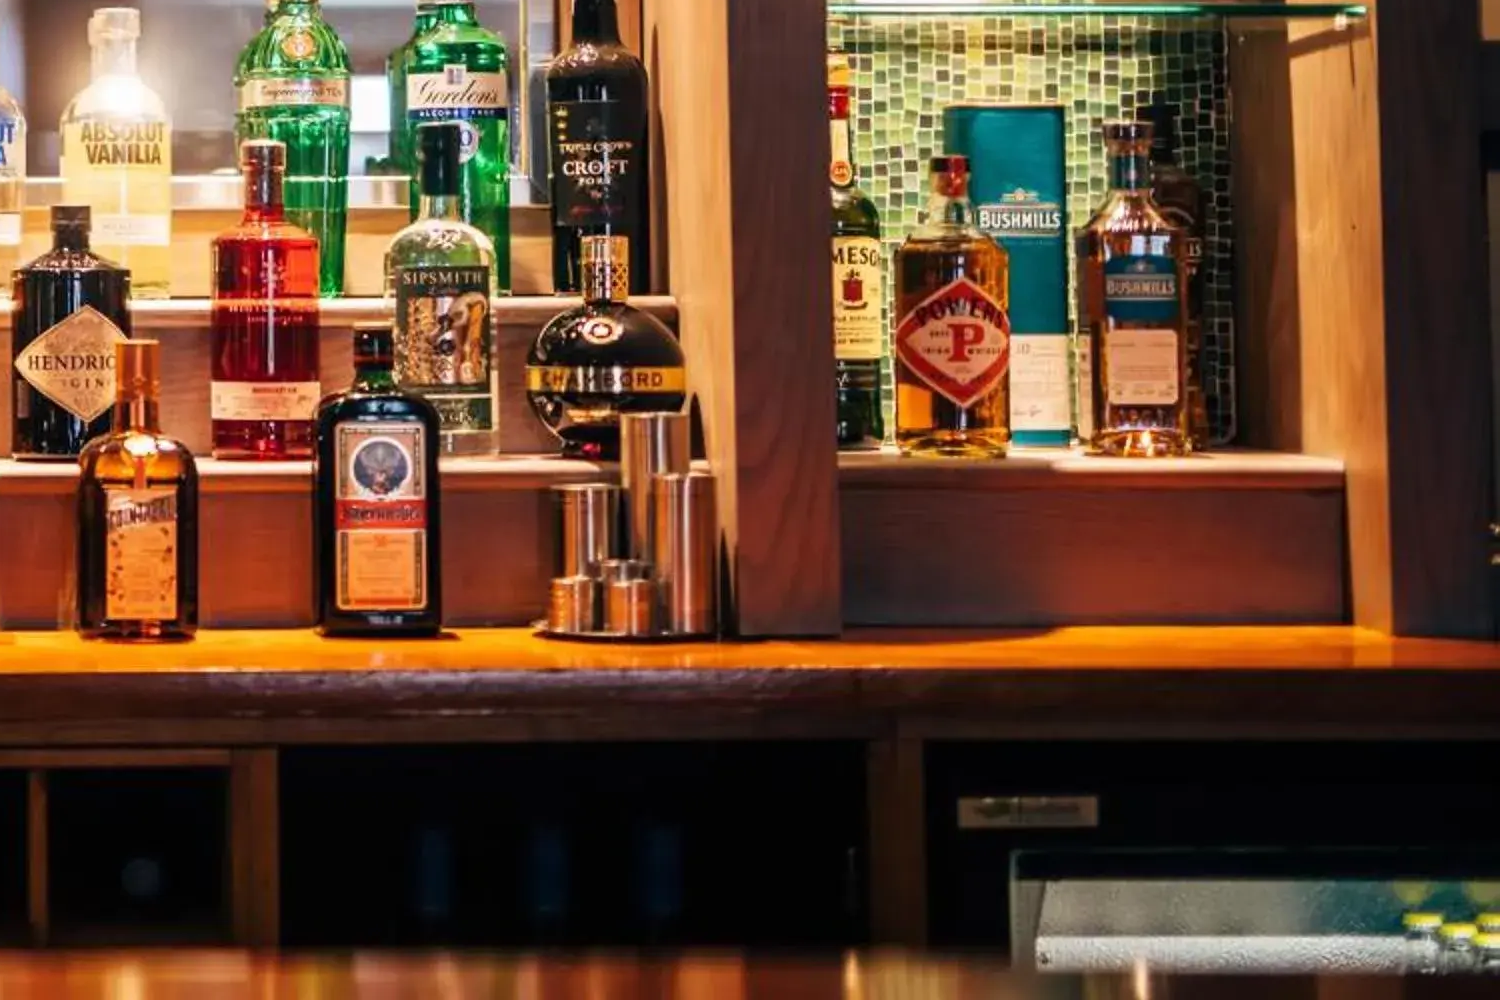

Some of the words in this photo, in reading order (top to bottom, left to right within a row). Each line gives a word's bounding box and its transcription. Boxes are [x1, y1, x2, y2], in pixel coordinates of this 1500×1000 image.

[418, 79, 499, 105] Gordon's
[80, 121, 164, 143] ABSOLUT
[85, 143, 161, 165] VANILIA
[562, 159, 628, 176] CROFT
[979, 209, 1062, 229] BUSHMILLS
[403, 271, 484, 286] SIPSMITH
[1105, 280, 1175, 296] BUSHMILLS
[913, 298, 1003, 329] POWERS
[947, 323, 985, 362] P
[28, 355, 117, 371] HENDRIC
[70, 378, 104, 389] GIN
